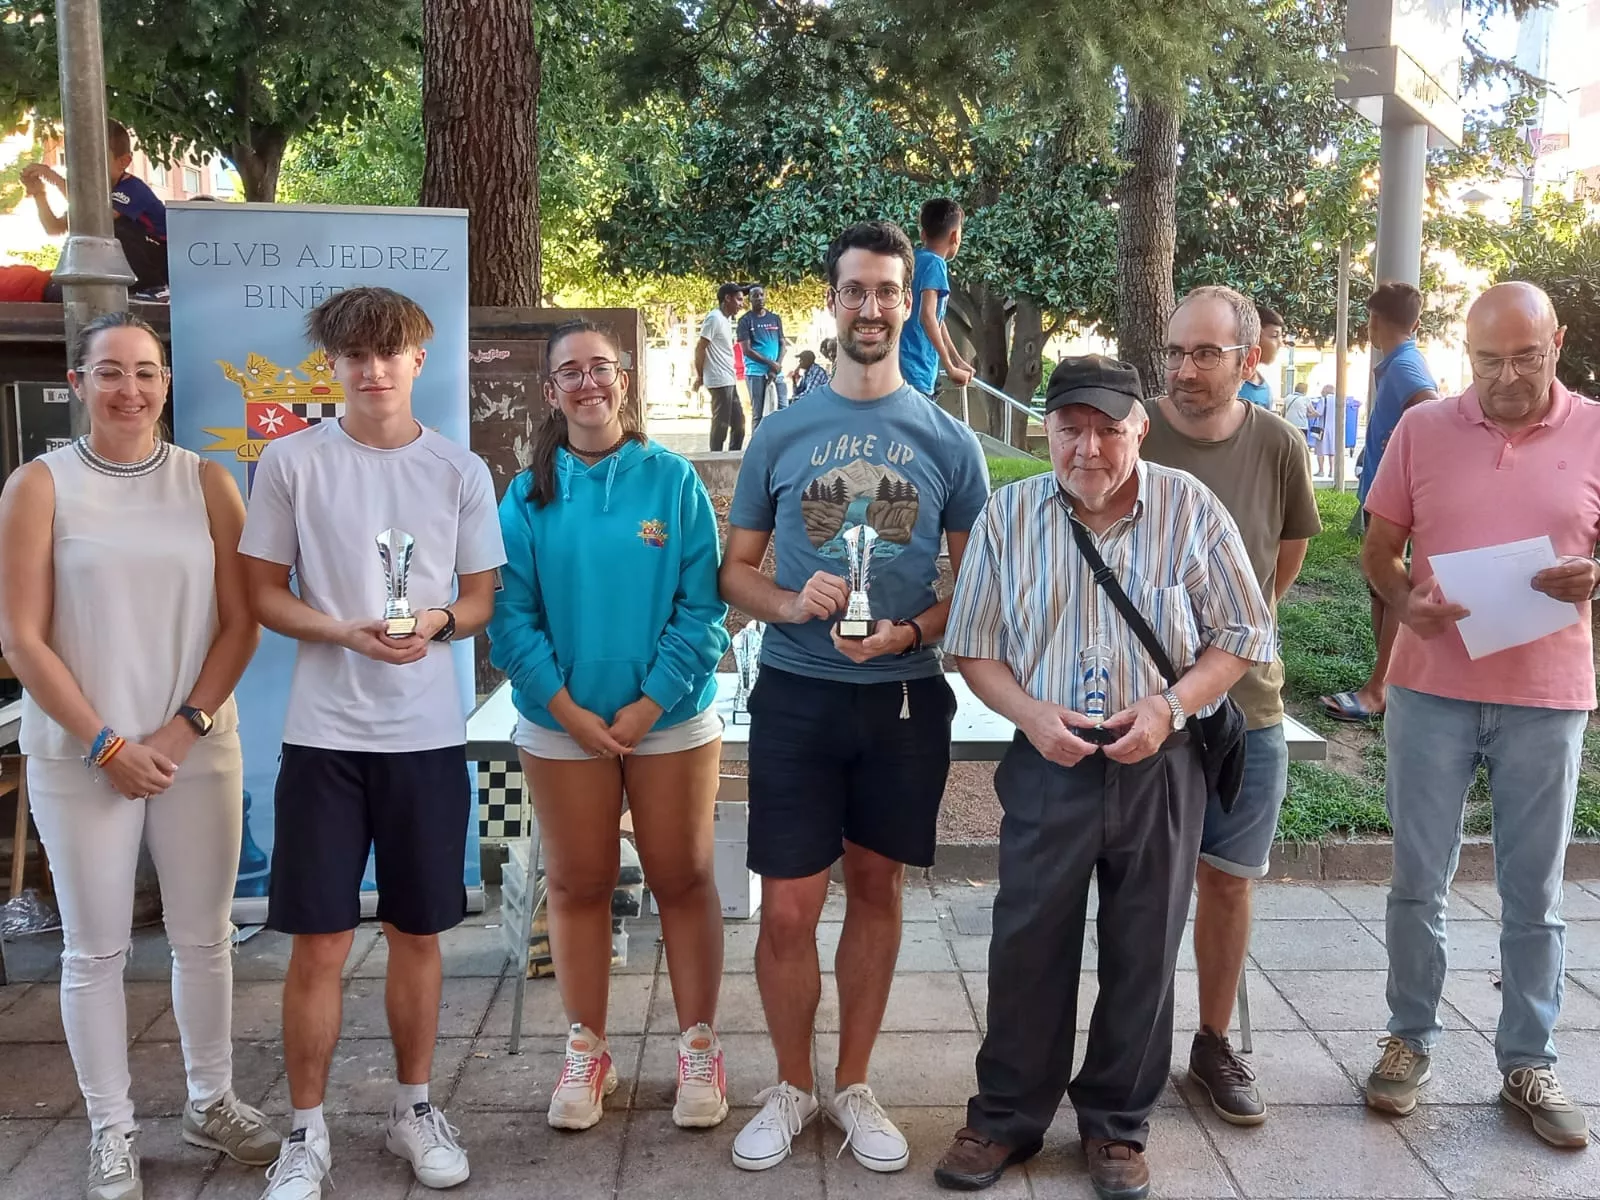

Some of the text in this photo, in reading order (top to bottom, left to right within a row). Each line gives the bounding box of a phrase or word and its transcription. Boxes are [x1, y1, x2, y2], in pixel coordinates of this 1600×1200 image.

[187, 242, 450, 271] CLVB AJEDREZ
[237, 443, 269, 457] CLV
[811, 434, 914, 466] WAKE UP
